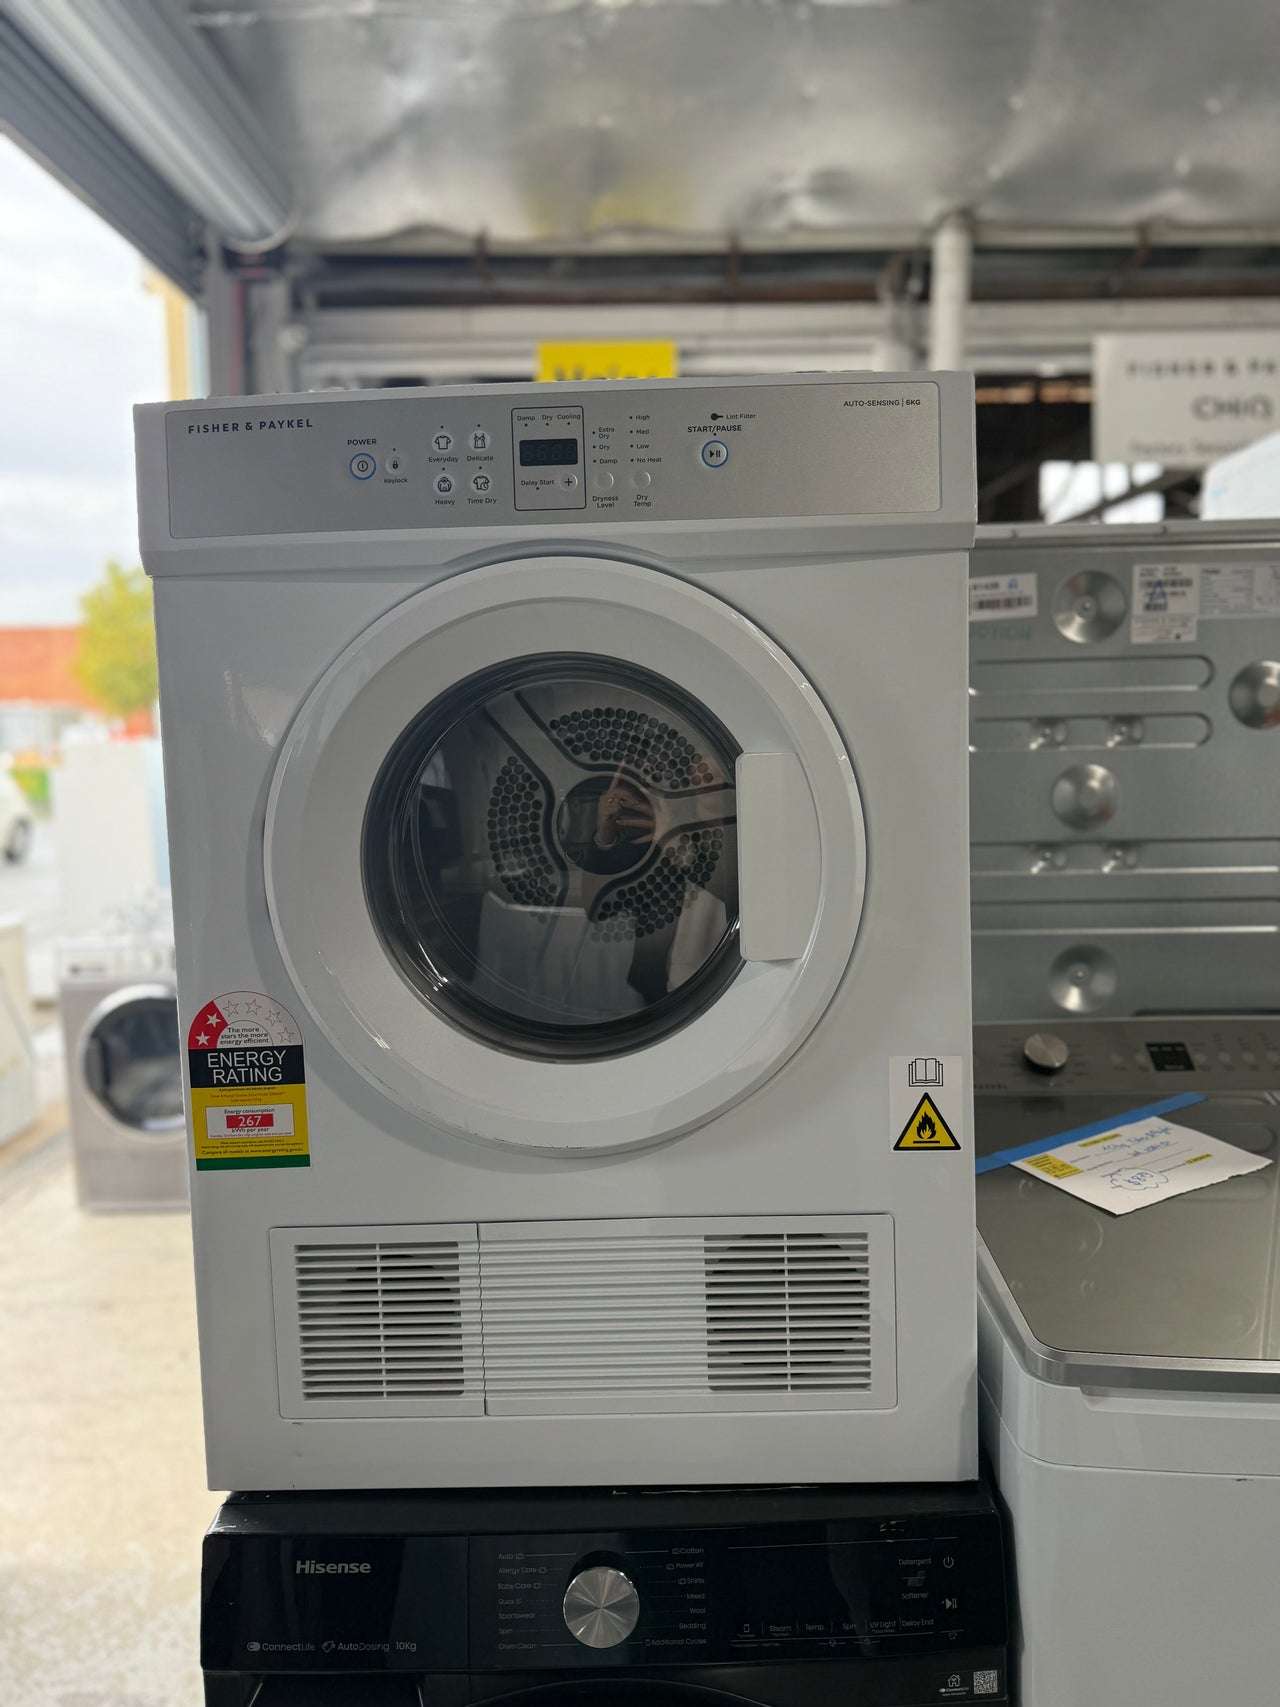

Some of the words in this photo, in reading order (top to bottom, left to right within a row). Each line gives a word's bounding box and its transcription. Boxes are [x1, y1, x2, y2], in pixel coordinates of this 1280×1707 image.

[843, 399, 900, 408] AUTO-SENSING
[905, 398, 921, 407] 6KG
[517, 415, 536, 423] Damp
[541, 414, 554, 422] Dry
[557, 413, 582, 421] Cooling
[188, 422, 240, 434] FISHER
[245, 421, 254, 431] &
[259, 418, 313, 430] PAYKEL
[687, 424, 742, 434] START/PAUSE
[347, 438, 377, 447] POWER
[428, 456, 459, 464] Everyday
[599, 458, 619, 466] Damp
[648, 456, 663, 464] Heat
[383, 477, 409, 485] Keylock
[521, 480, 539, 488] Delay
[539, 479, 556, 487] Start
[434, 498, 456, 506] Heavy
[467, 498, 483, 506] Time
[485, 497, 497, 505] Dry
[592, 495, 620, 503] Dryness
[636, 494, 650, 502] Dry
[596, 502, 616, 510] Level
[633, 500, 653, 509] Temp
[207, 1050, 286, 1068] ENERGY
[213, 1067, 282, 1084] RATING
[237, 1115, 262, 1127] 267
[296, 1560, 372, 1574] Hisense
[898, 1558, 932, 1567] Detergent
[805, 1623, 825, 1632] Temp
[901, 1619, 920, 1628] Delay
[921, 1618, 934, 1626] End
[262, 1641, 316, 1652] ConnectLife
[337, 1641, 390, 1653] AutoDosing
[396, 1641, 417, 1653] 10Kg
